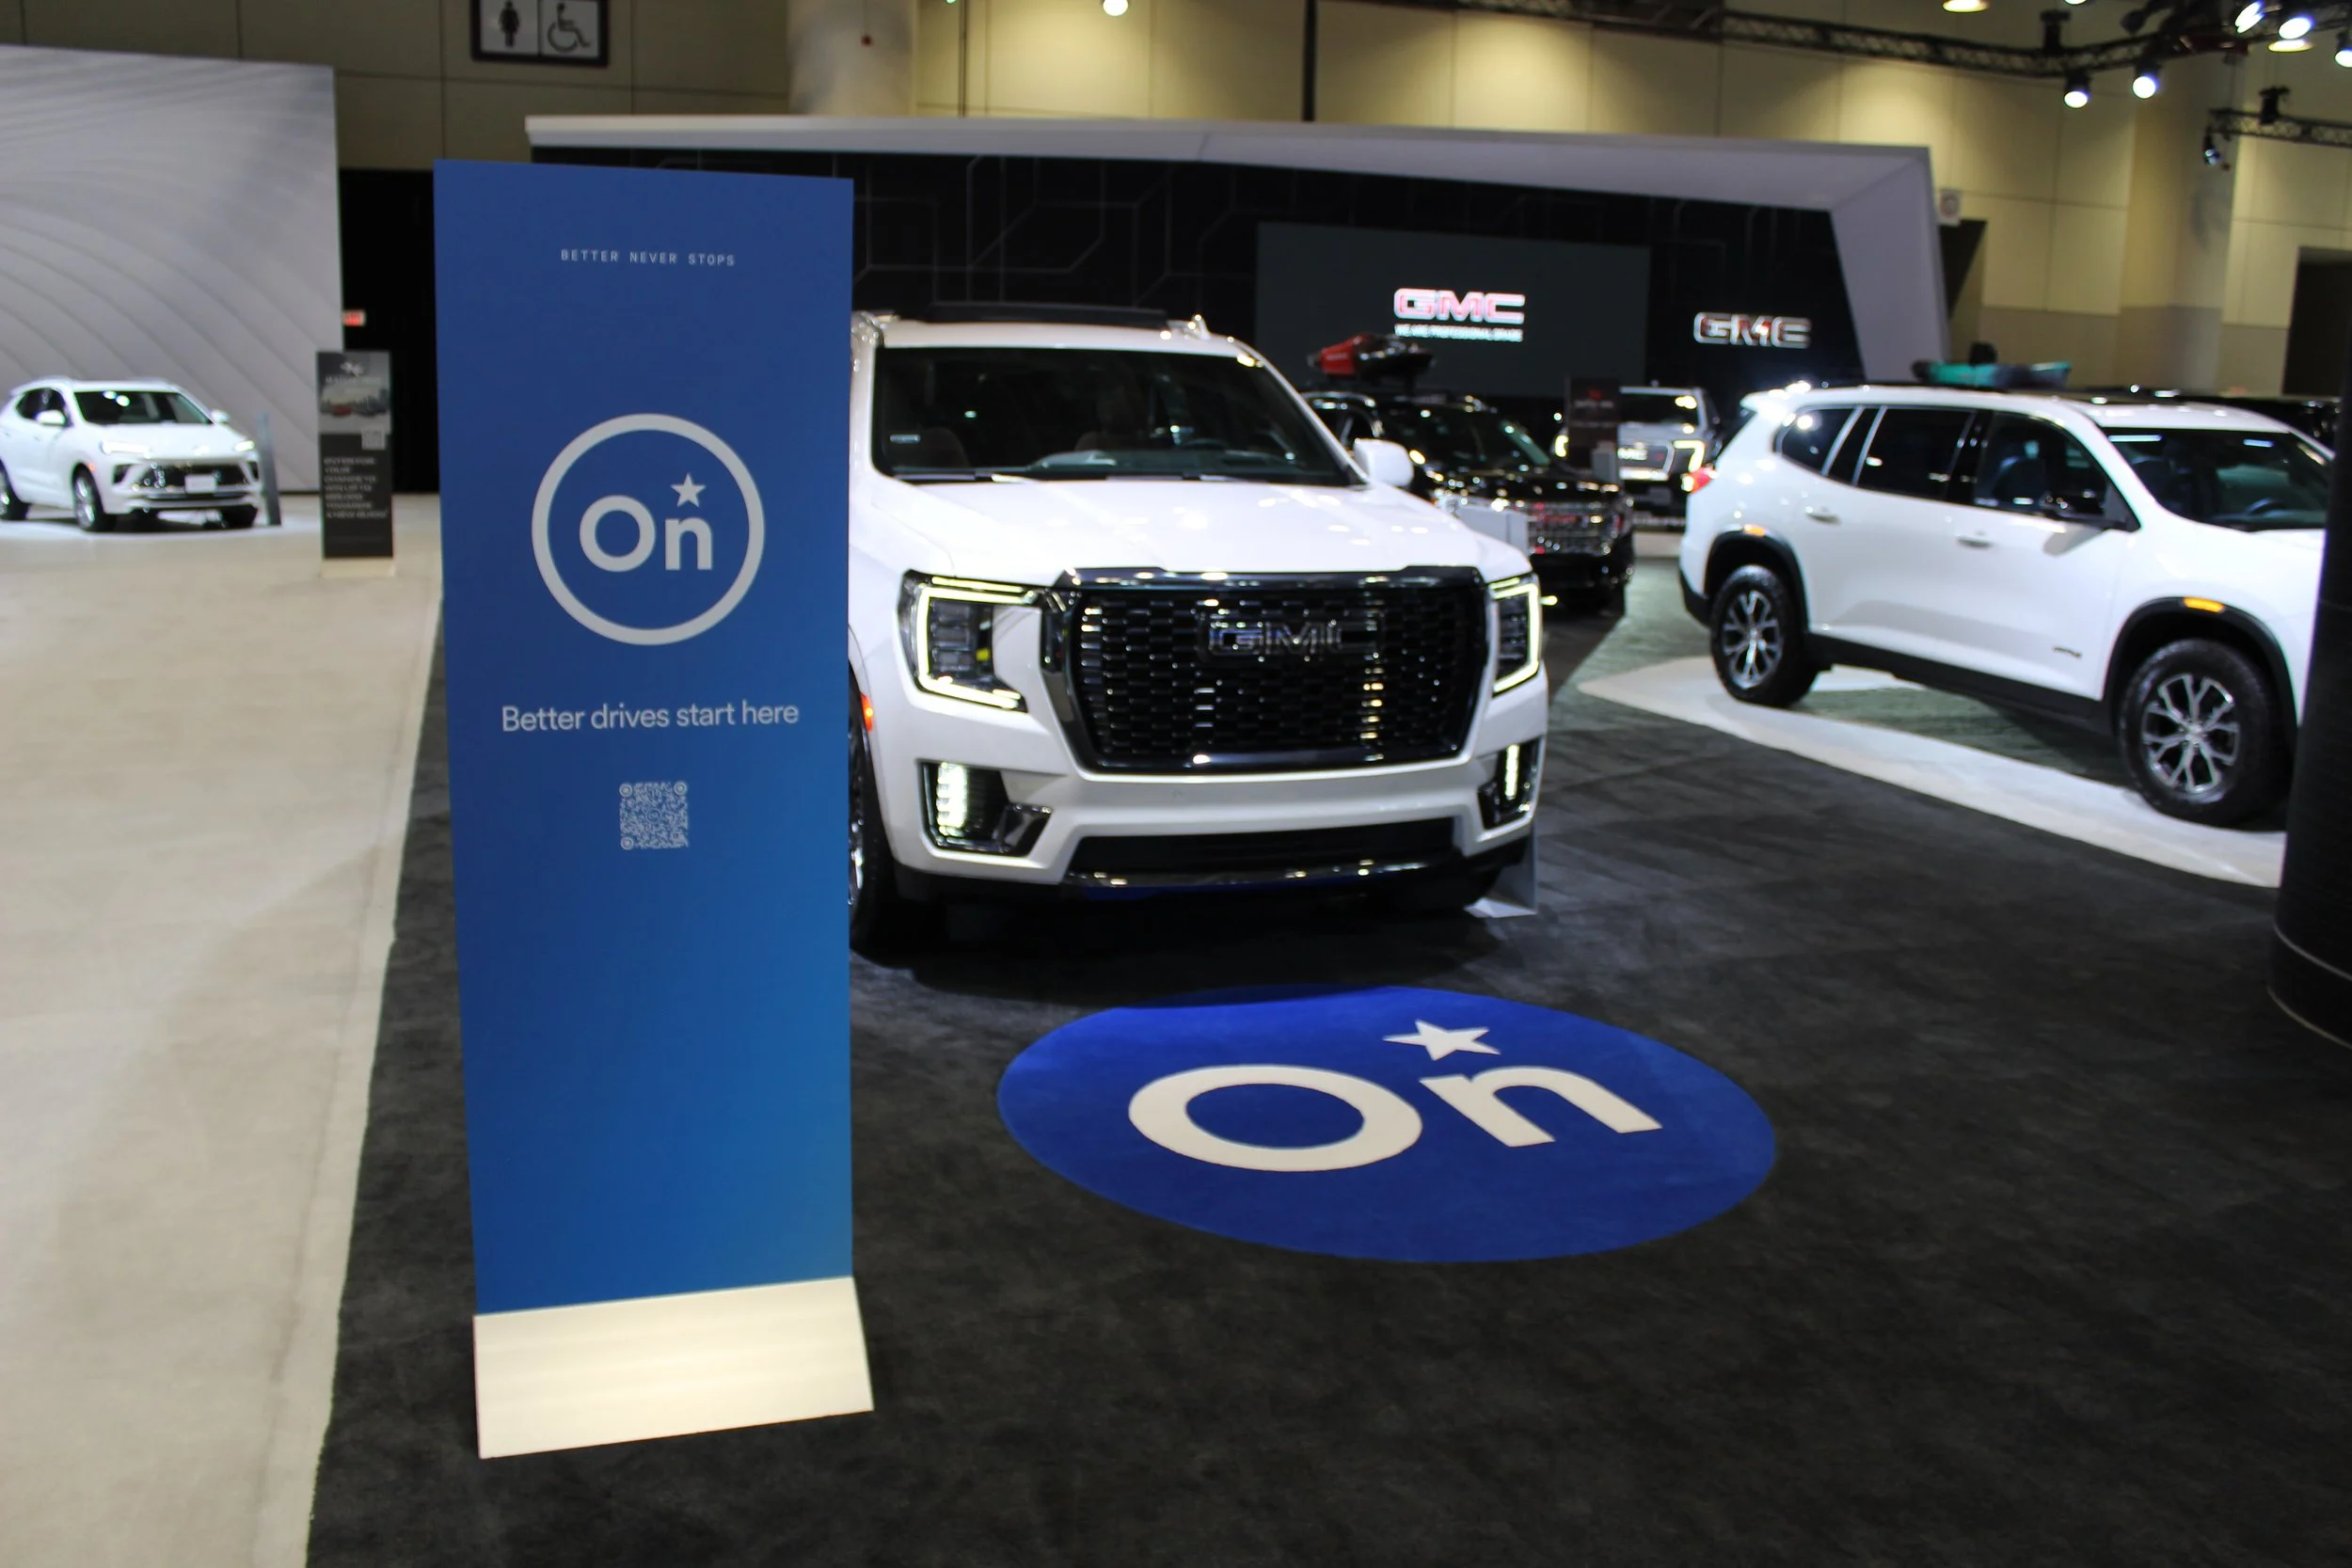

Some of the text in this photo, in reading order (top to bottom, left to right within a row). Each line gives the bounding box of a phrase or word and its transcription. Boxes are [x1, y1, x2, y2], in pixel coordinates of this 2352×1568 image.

[561, 248, 735, 266] BETTER NEVER STOPS
[1394, 288, 1526, 325] GMC
[1693, 311, 1811, 348] GMC
[580, 495, 712, 572] On
[1208, 622, 1378, 656] GMC
[501, 700, 800, 732] Better drives start here
[1129, 1064, 1662, 1172] On
